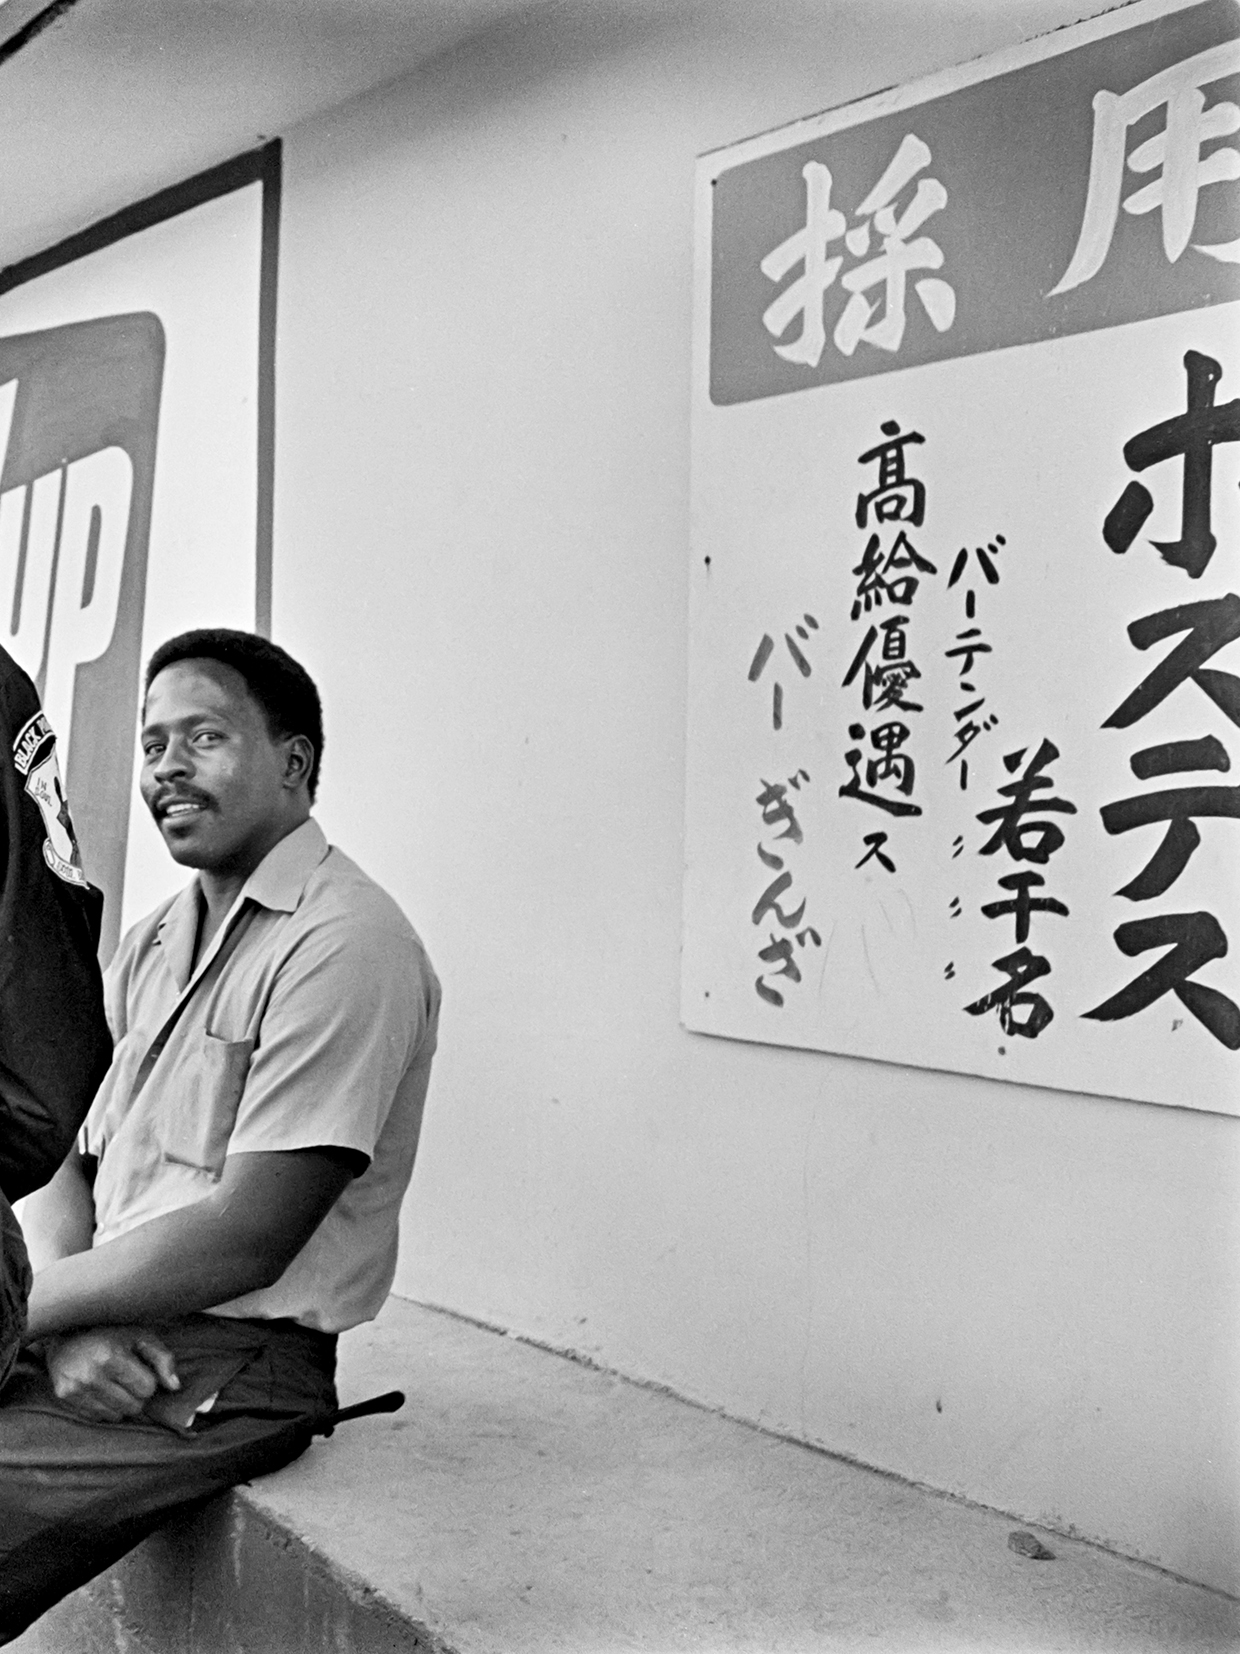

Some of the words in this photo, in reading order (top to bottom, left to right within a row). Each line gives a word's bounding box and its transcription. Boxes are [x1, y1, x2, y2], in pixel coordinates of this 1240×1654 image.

[14, 726, 42, 768] BLACK
[748, 613, 820, 731] バー
[944, 534, 1007, 791] バーテンダー
[1080, 349, 1240, 1051] ホステス
[752, 768, 822, 1008] ぎんざ
[963, 737, 1078, 1040] 若干名
